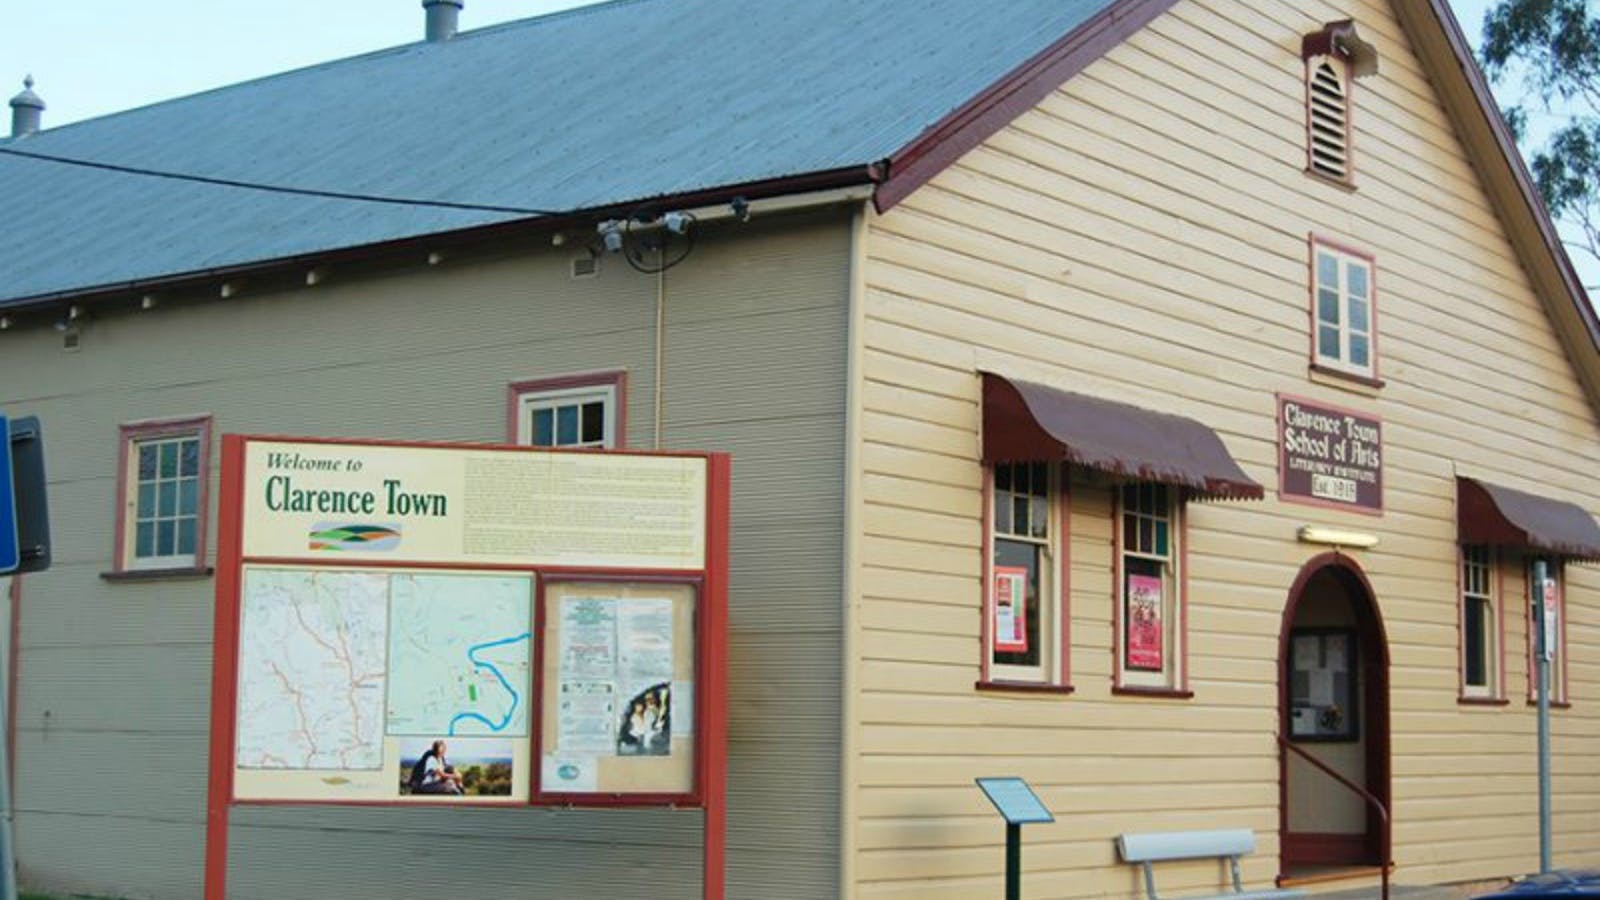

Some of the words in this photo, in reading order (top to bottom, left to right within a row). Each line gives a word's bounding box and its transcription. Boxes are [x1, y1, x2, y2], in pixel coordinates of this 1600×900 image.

[1285, 403, 1341, 435] Clarence
[1343, 416, 1379, 444] Town
[266, 453, 342, 471] Welcome
[346, 458, 363, 472] to
[1285, 427, 1329, 459] School
[1333, 439, 1347, 462] of
[1351, 440, 1379, 469] Arts
[265, 475, 375, 514] Clarence
[383, 479, 447, 517] Town
